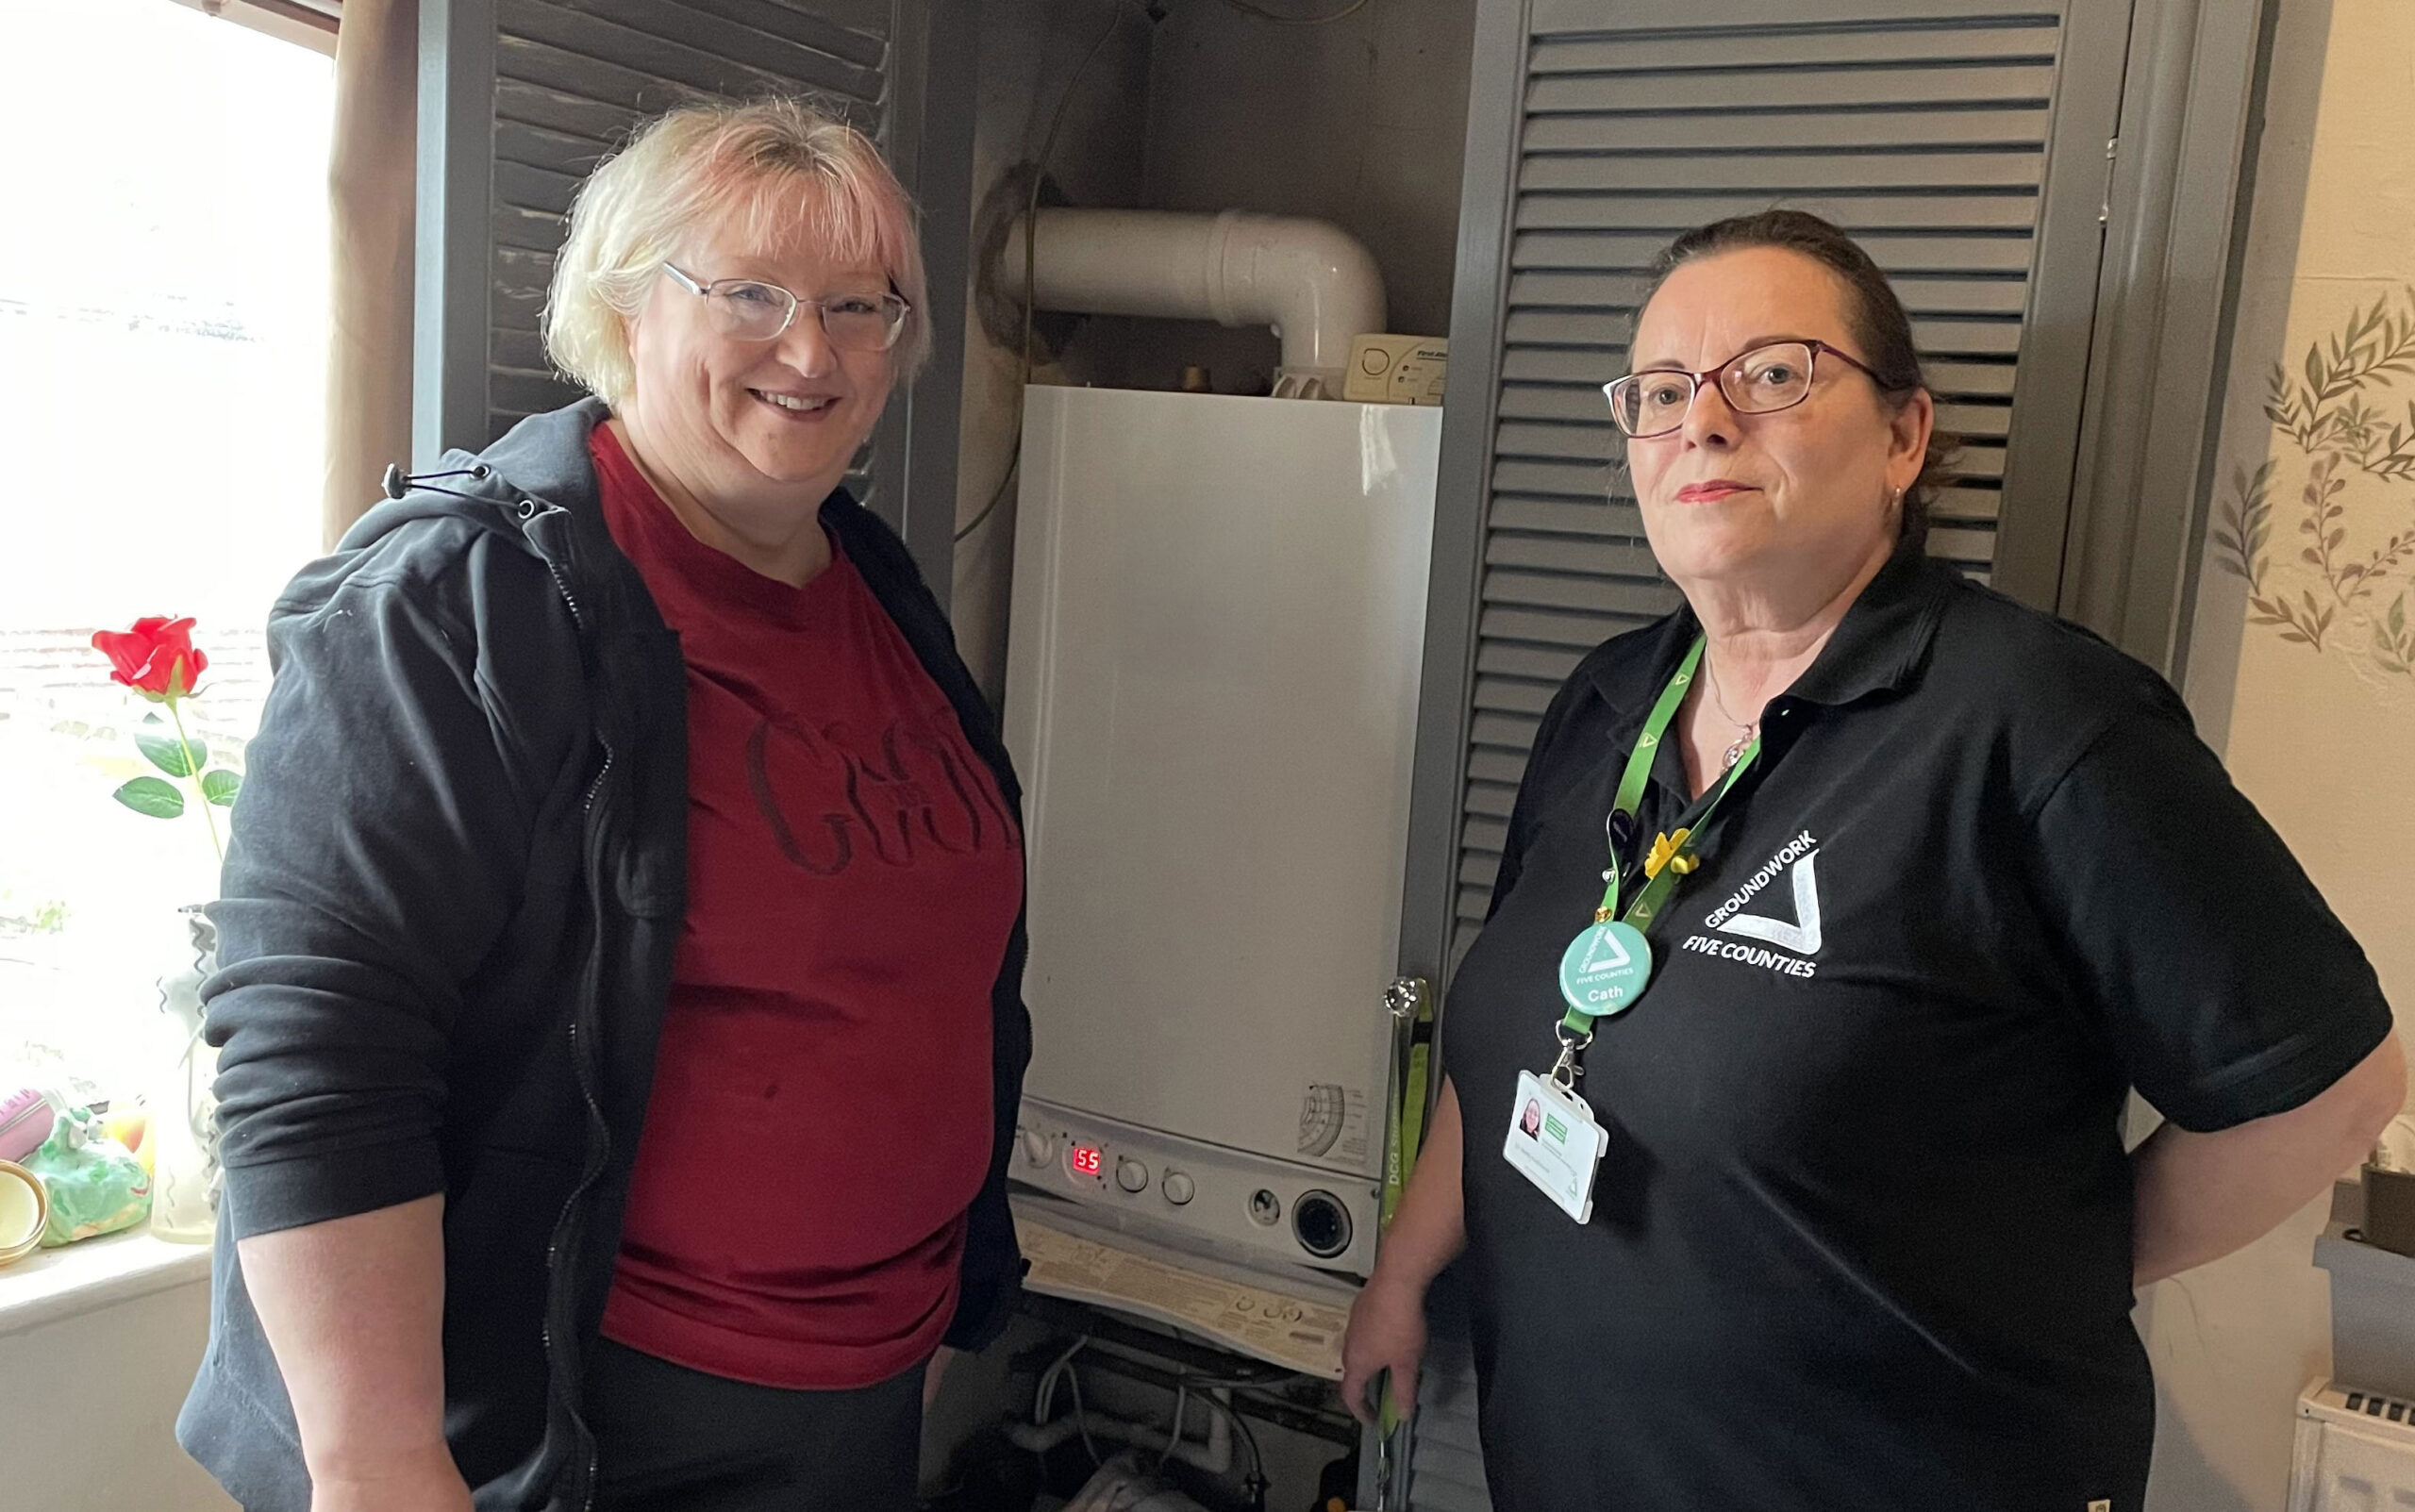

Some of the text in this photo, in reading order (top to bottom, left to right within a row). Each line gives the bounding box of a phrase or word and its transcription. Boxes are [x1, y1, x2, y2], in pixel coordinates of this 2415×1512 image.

[1705, 829, 1818, 928] GROUNDWORK
[1682, 935, 1817, 978] FIVE COUNTIES
[1576, 967, 1634, 985] FIVE COUNTIES
[1588, 986, 1624, 1002] Cath
[1078, 1149, 1099, 1170] 55
[1389, 1152, 1400, 1186] DCG
